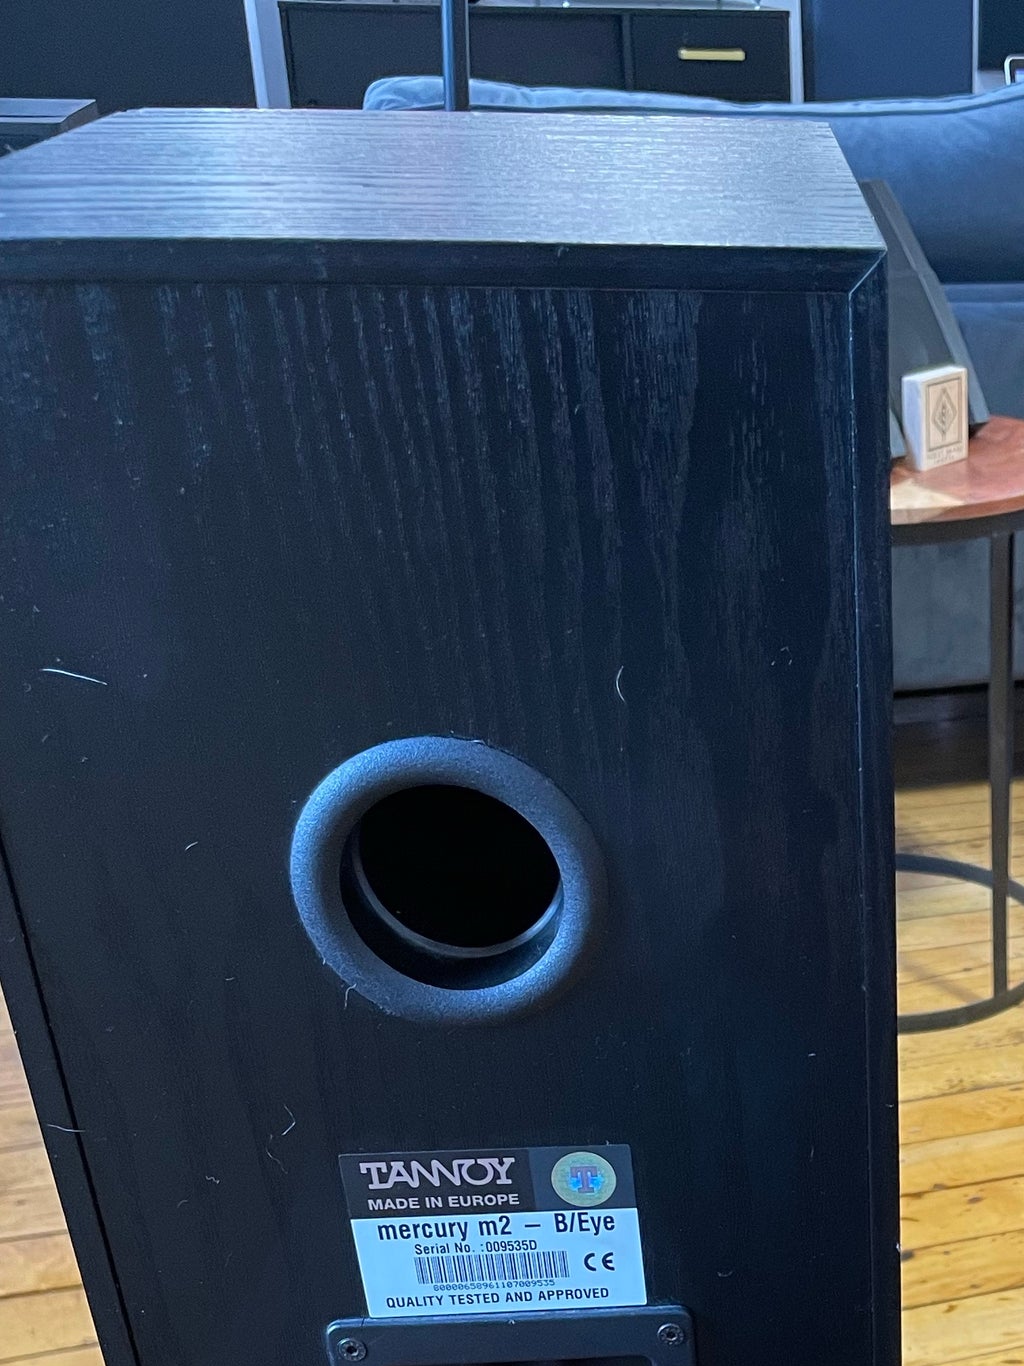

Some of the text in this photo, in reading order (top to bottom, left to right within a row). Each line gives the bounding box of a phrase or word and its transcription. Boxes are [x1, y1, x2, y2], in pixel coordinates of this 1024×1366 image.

[359, 1157, 515, 1190] TANNOY
[570, 1166, 598, 1194] T
[367, 1193, 520, 1211] MADE IN EUROPE
[377, 1221, 468, 1241] mercury
[478, 1215, 512, 1236] m2
[554, 1212, 615, 1236] B/Eye
[414, 1243, 450, 1255] Serial
[583, 1251, 615, 1271] CE
[386, 1287, 609, 1308] QUALITY TESTED AND APPROVED
